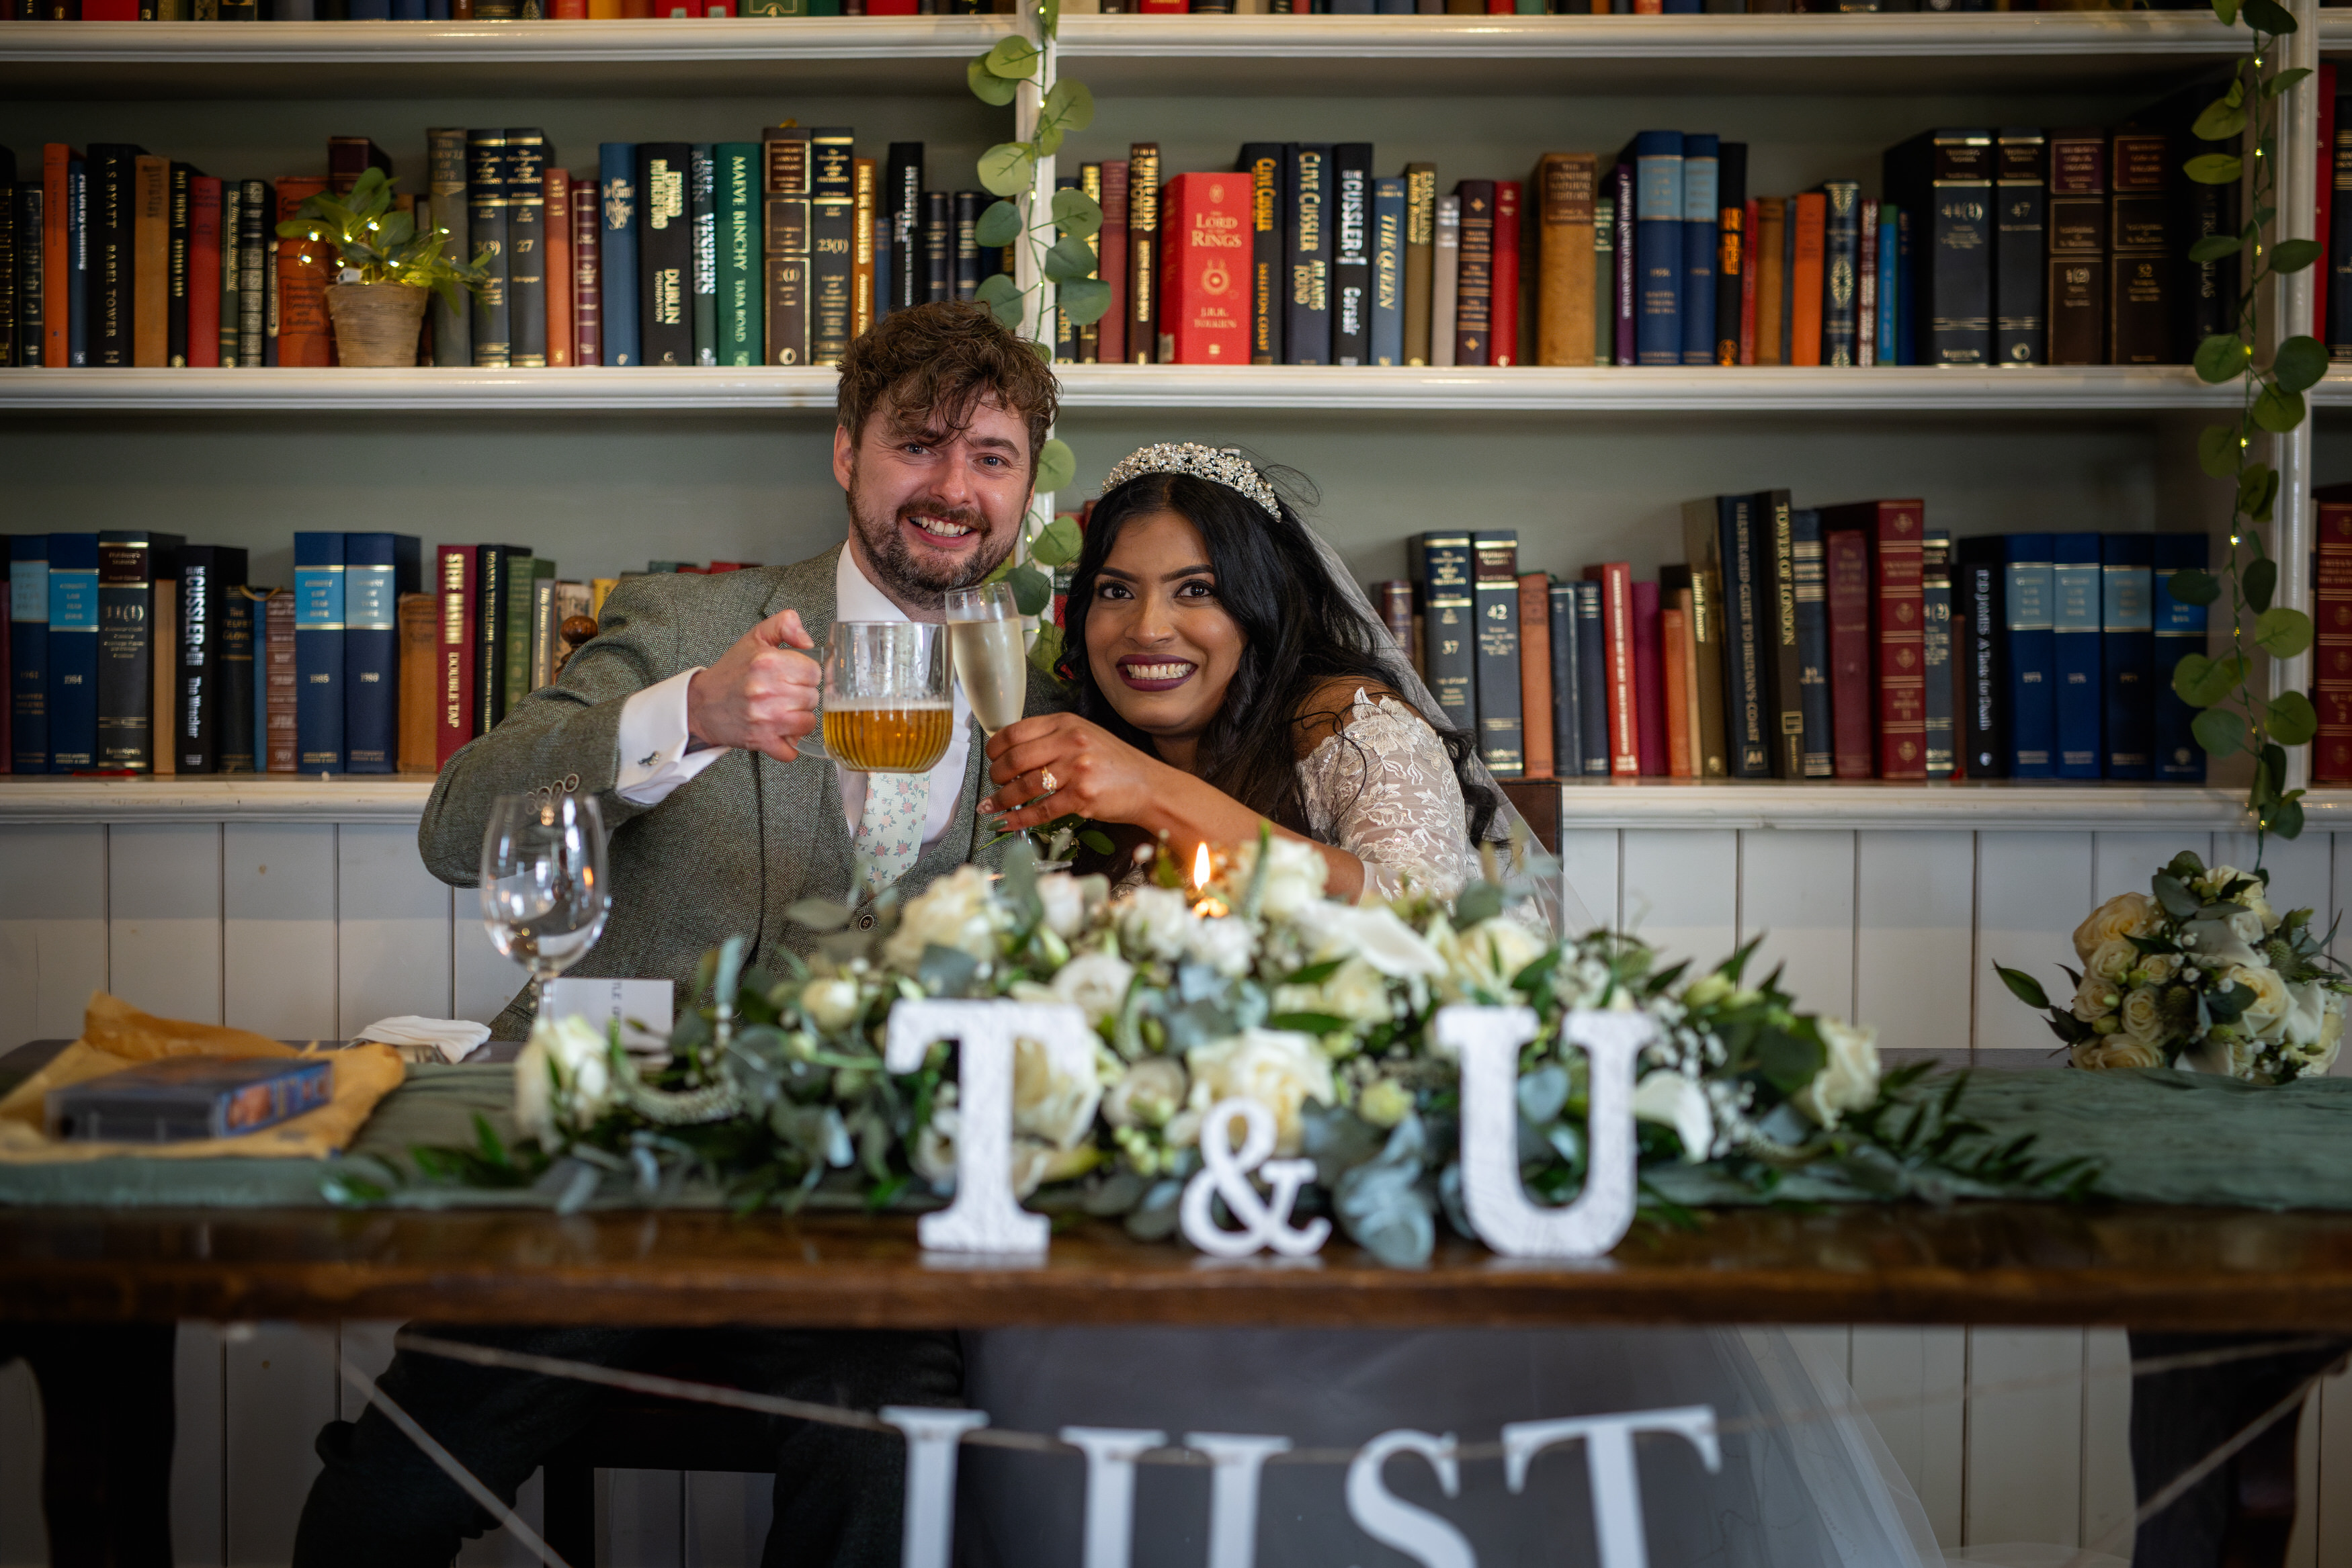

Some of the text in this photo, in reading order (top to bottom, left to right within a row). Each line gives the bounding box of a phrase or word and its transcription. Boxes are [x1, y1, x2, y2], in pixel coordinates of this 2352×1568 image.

[106, 183, 118, 229] BYATT
[732, 156, 748, 271] MAEVE BINCHY
[1195, 214, 1238, 230] LORD
[1298, 151, 1321, 252] CLIVE CUSSLER
[1341, 179, 1363, 251] CUSSLER
[516, 238, 534, 253] 27
[693, 212, 715, 295] VESPERS
[1191, 230, 1243, 249] RINGS
[1380, 213, 1398, 251] THE
[106, 244, 118, 338] BABEL TOWER
[664, 269, 680, 324] DUBLIN
[1376, 251, 1397, 311] QUEEN
[1257, 316, 1269, 351] COAST
[1341, 286, 1361, 335] Corsair
[444, 554, 465, 591] STEVE
[1775, 502, 1796, 646] TOWER OF LONDON
[185, 576, 206, 645] CUSSLER
[1487, 603, 1508, 620] 42
[1443, 640, 1459, 656] 37
[188, 676, 202, 738] The Wrecker
[448, 652, 460, 728] DOUBLE TAP
[1746, 702, 1760, 743] COAST
[886, 1000, 1656, 1259] T & U
